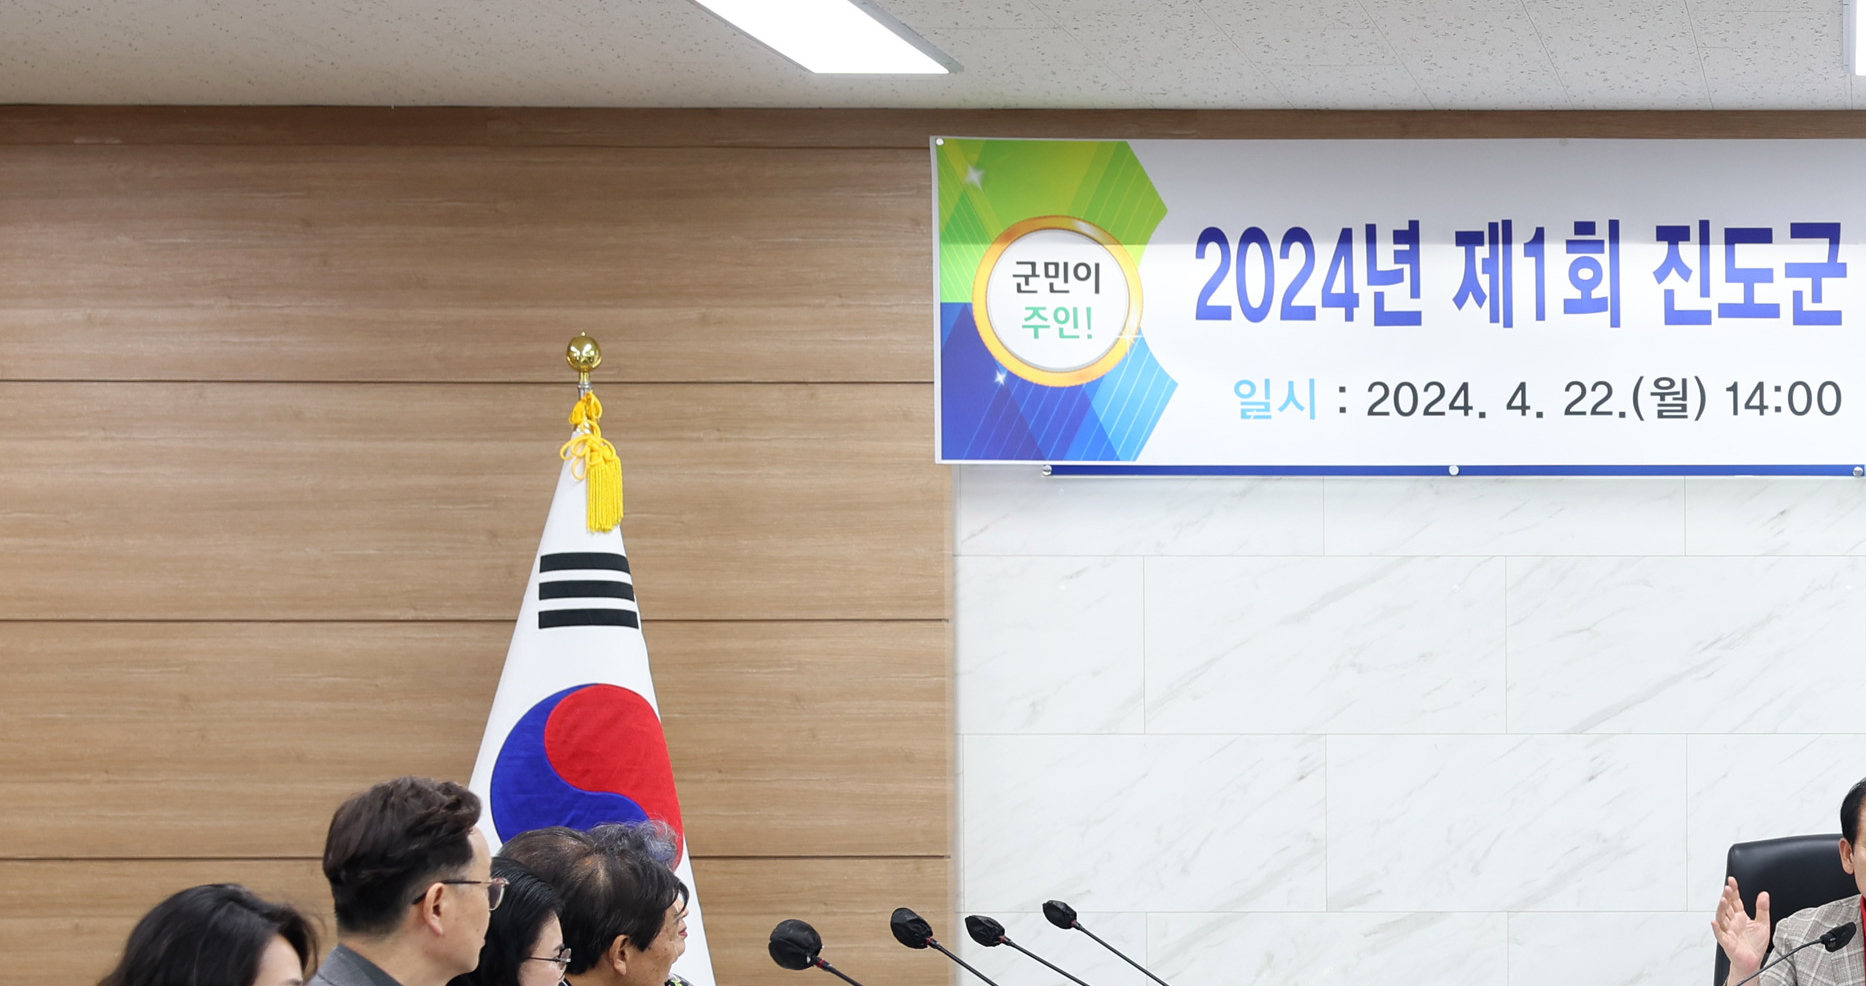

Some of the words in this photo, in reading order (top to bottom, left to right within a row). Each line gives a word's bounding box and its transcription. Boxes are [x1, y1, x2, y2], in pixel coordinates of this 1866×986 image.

[1012, 261, 1101, 294] 군민이
[1195, 219, 1422, 326] 2024년
[1452, 219, 1621, 328] 제1회
[1653, 219, 1848, 326] 진도군
[1021, 304, 1093, 340] 주인!
[1233, 378, 1317, 420] 일시
[1367, 381, 1487, 418] 2024.
[1505, 381, 1544, 418] 4.
[1563, 375, 1707, 421] 22.(월)
[1726, 380, 1842, 417] 14:00
